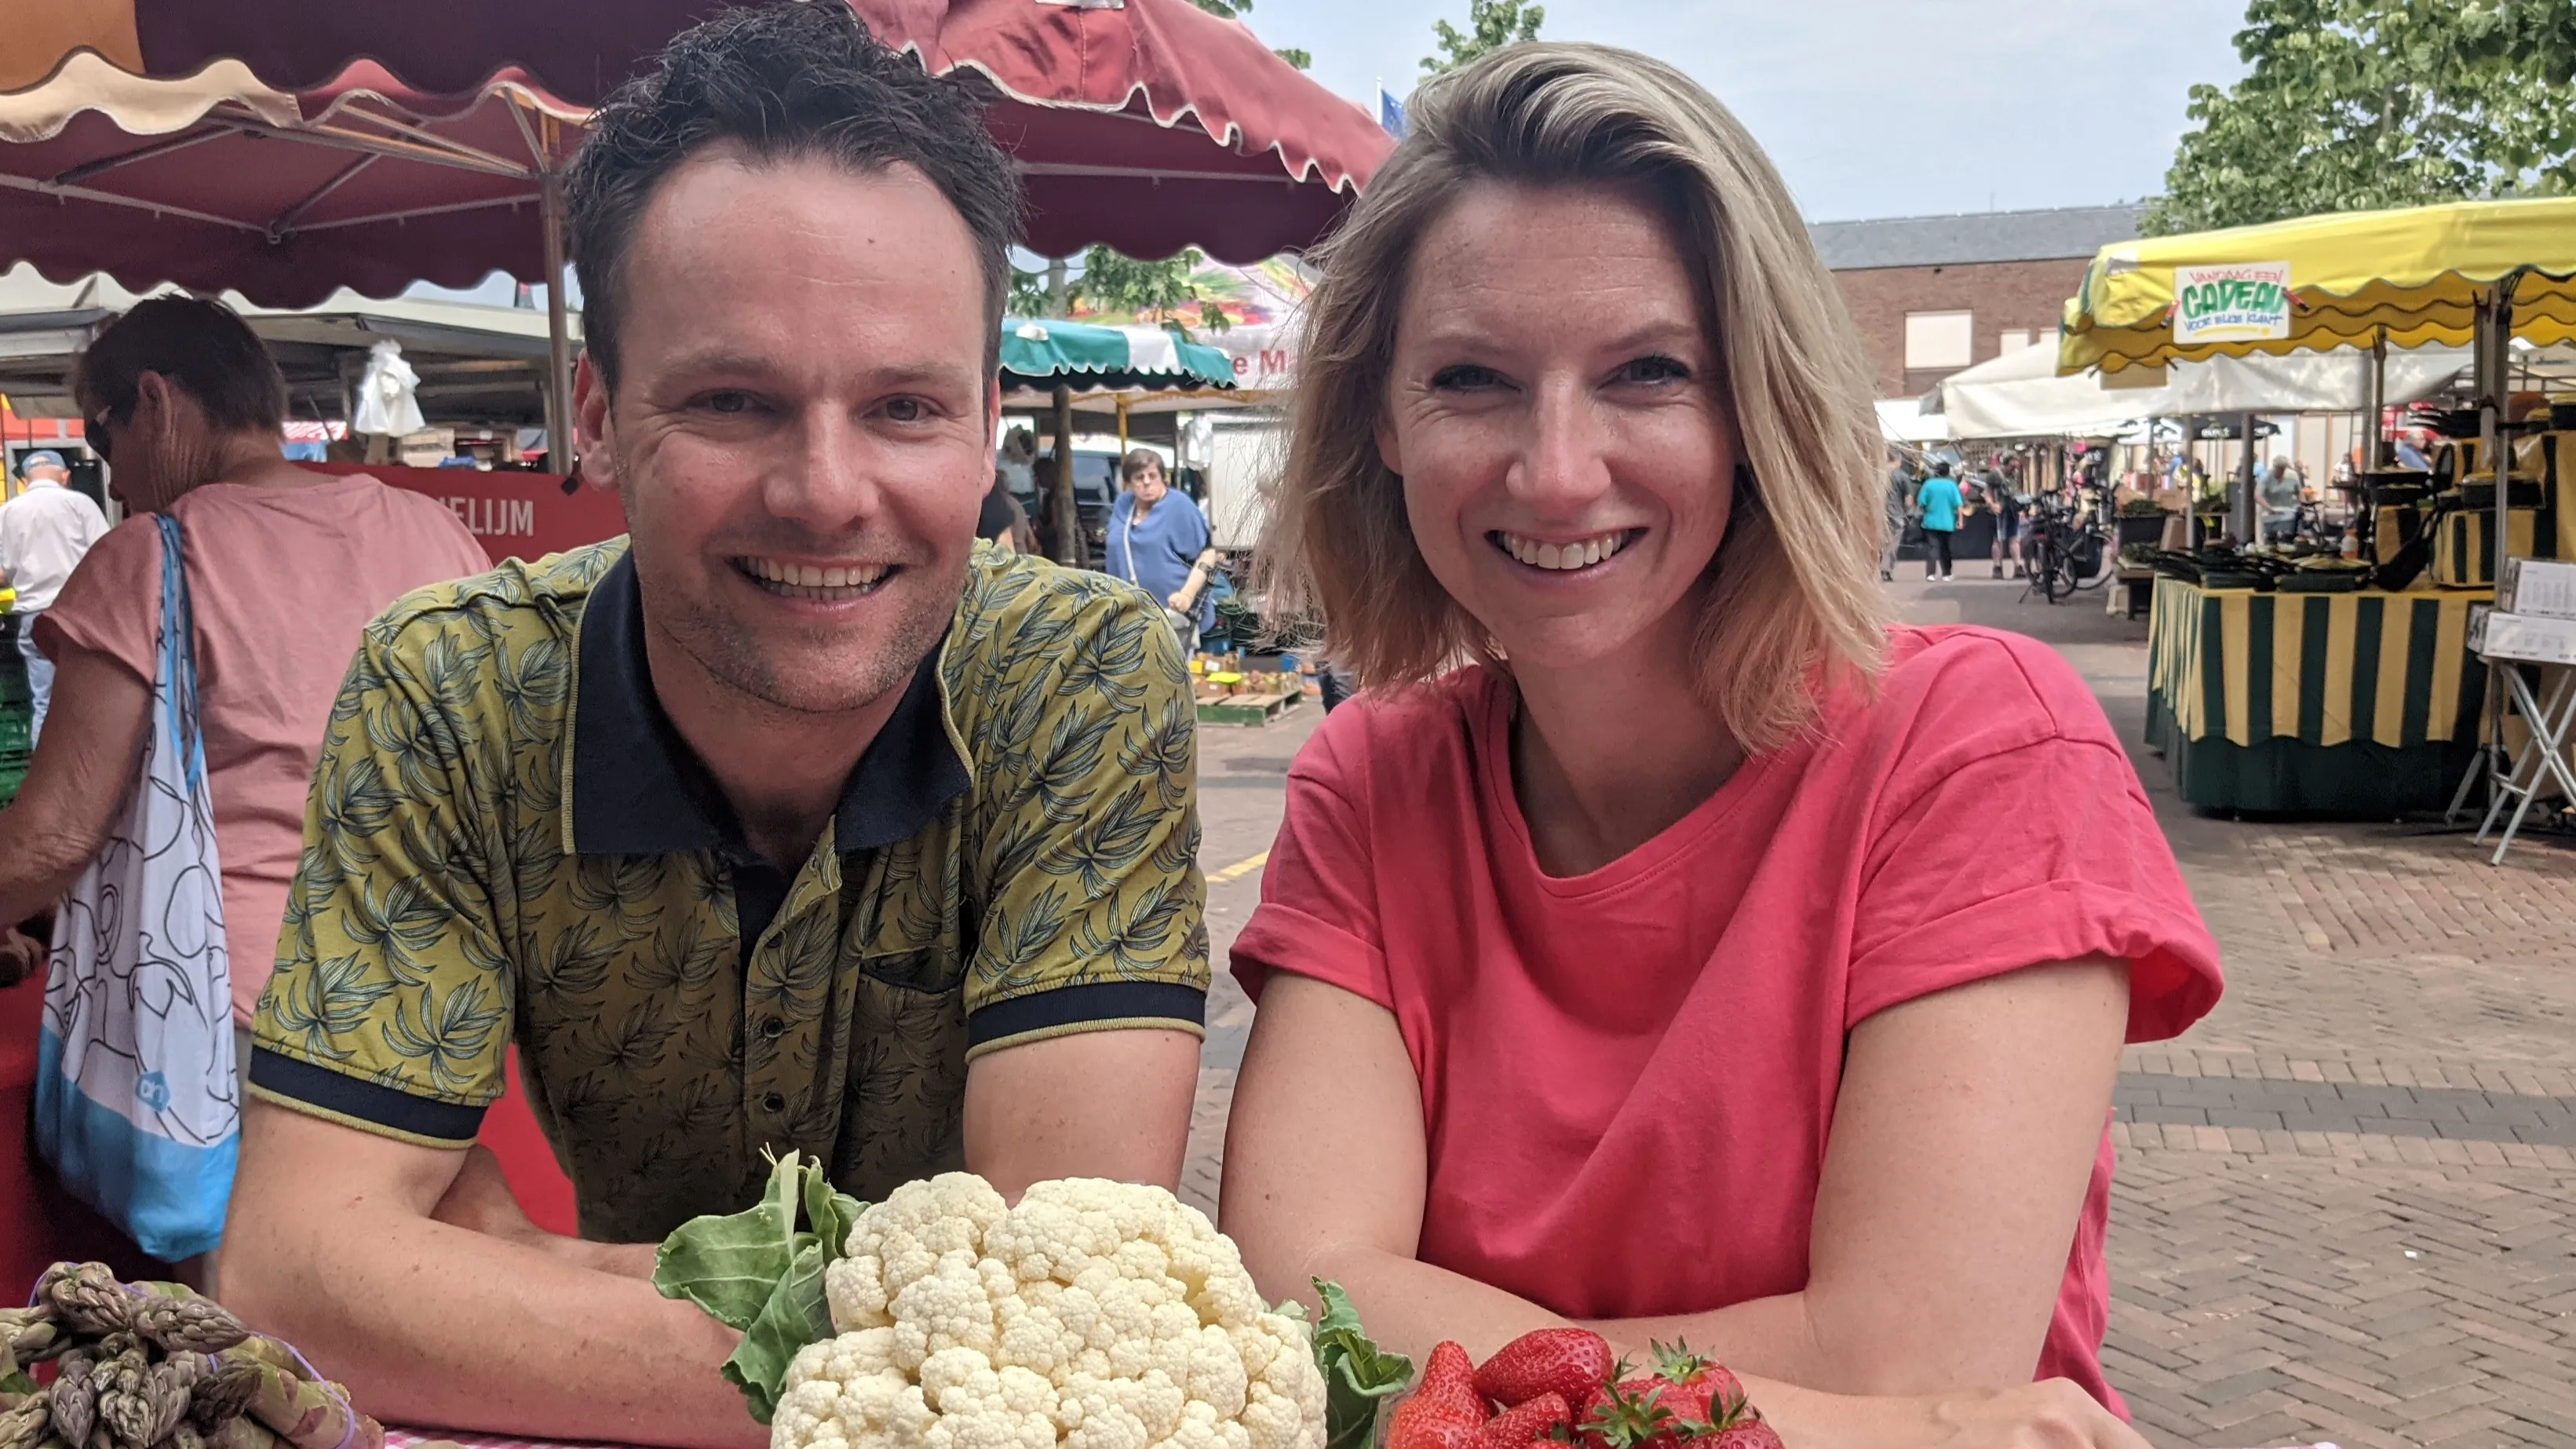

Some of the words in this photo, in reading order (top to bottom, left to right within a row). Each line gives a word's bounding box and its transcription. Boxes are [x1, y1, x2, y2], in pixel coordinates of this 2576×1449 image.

[2254, 269, 2283, 283] EEN
[2181, 279, 2285, 319] CADEAU
[437, 495, 535, 537] ELIJM
